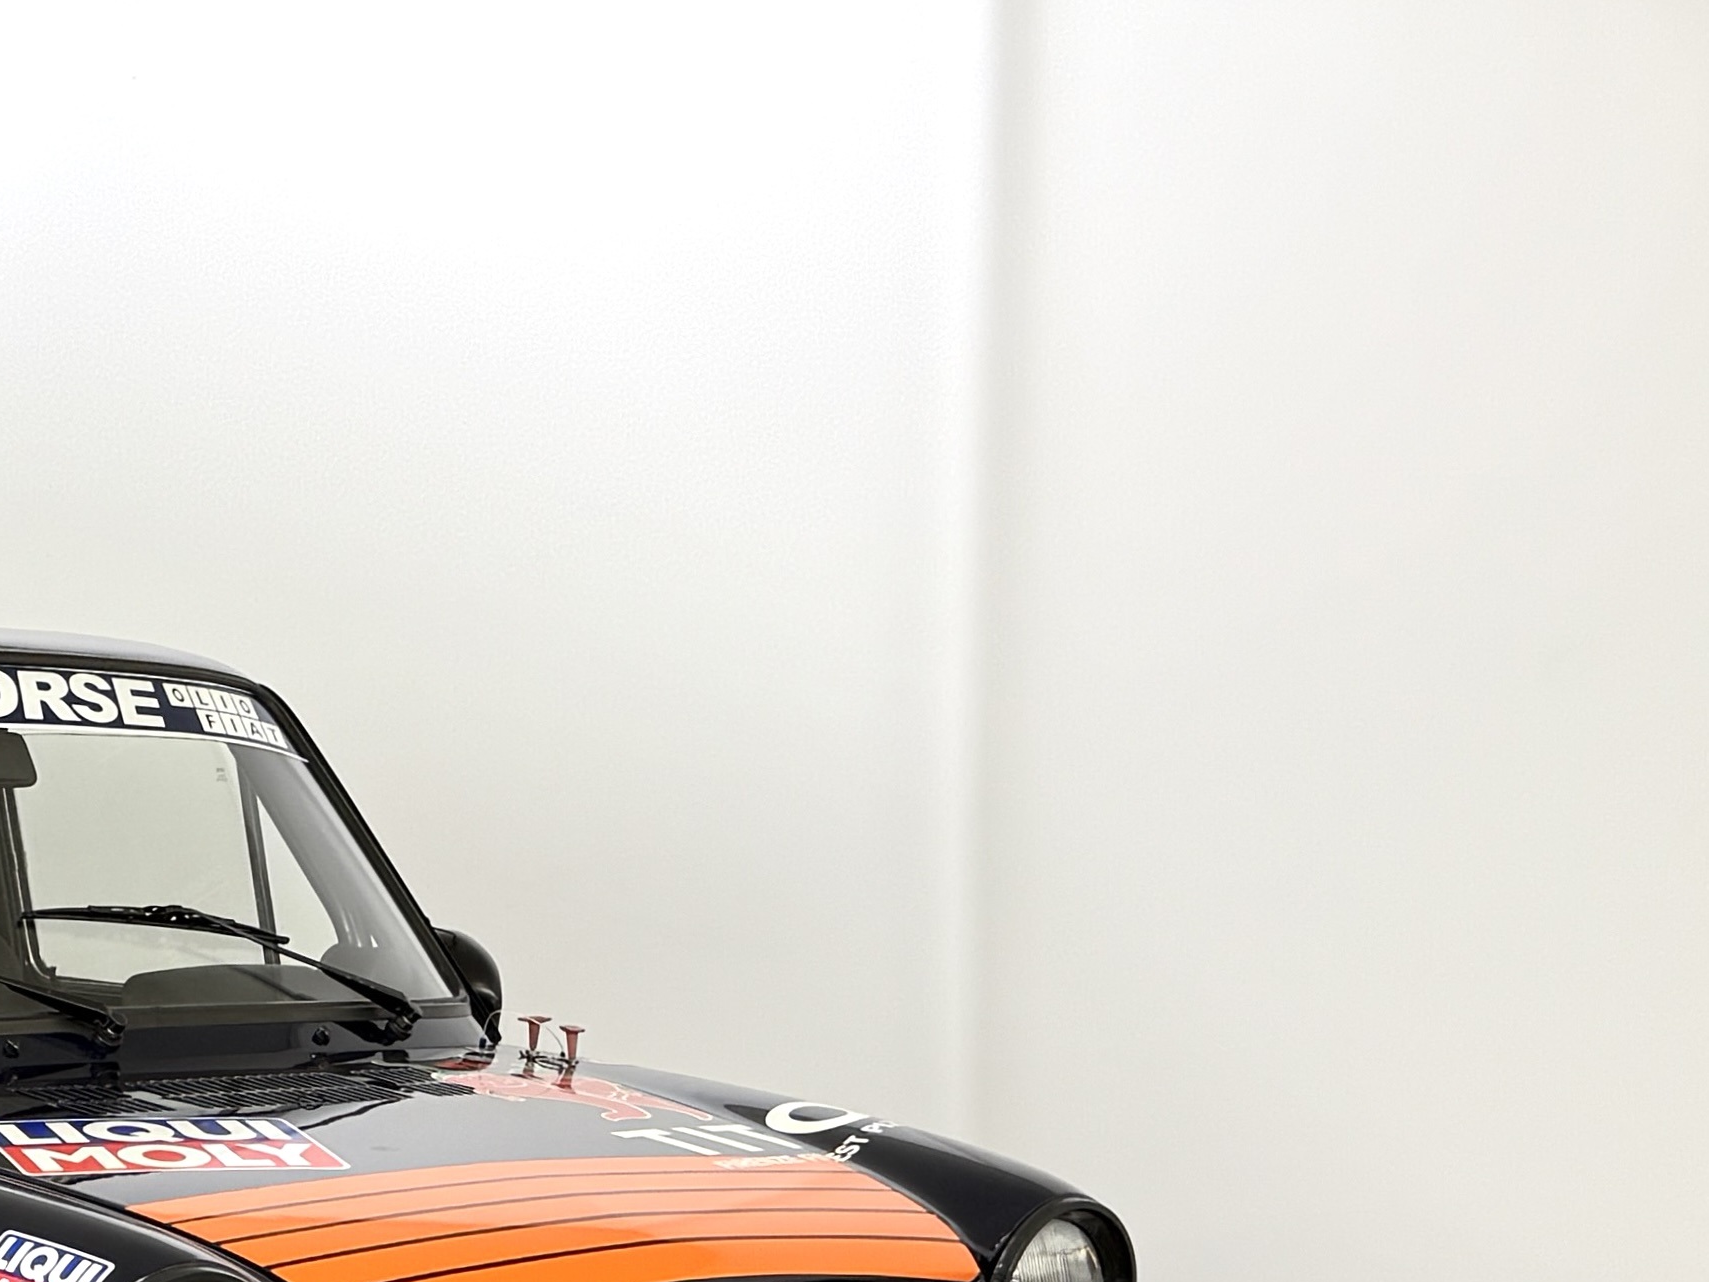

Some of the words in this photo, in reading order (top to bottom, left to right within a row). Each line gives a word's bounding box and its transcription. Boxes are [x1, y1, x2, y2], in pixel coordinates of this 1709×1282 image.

[170, 685, 253, 716] OLIO
[204, 712, 281, 744] FIAT
[611, 1101, 871, 1156] TITO
[21, 1143, 311, 1172] MOLY
